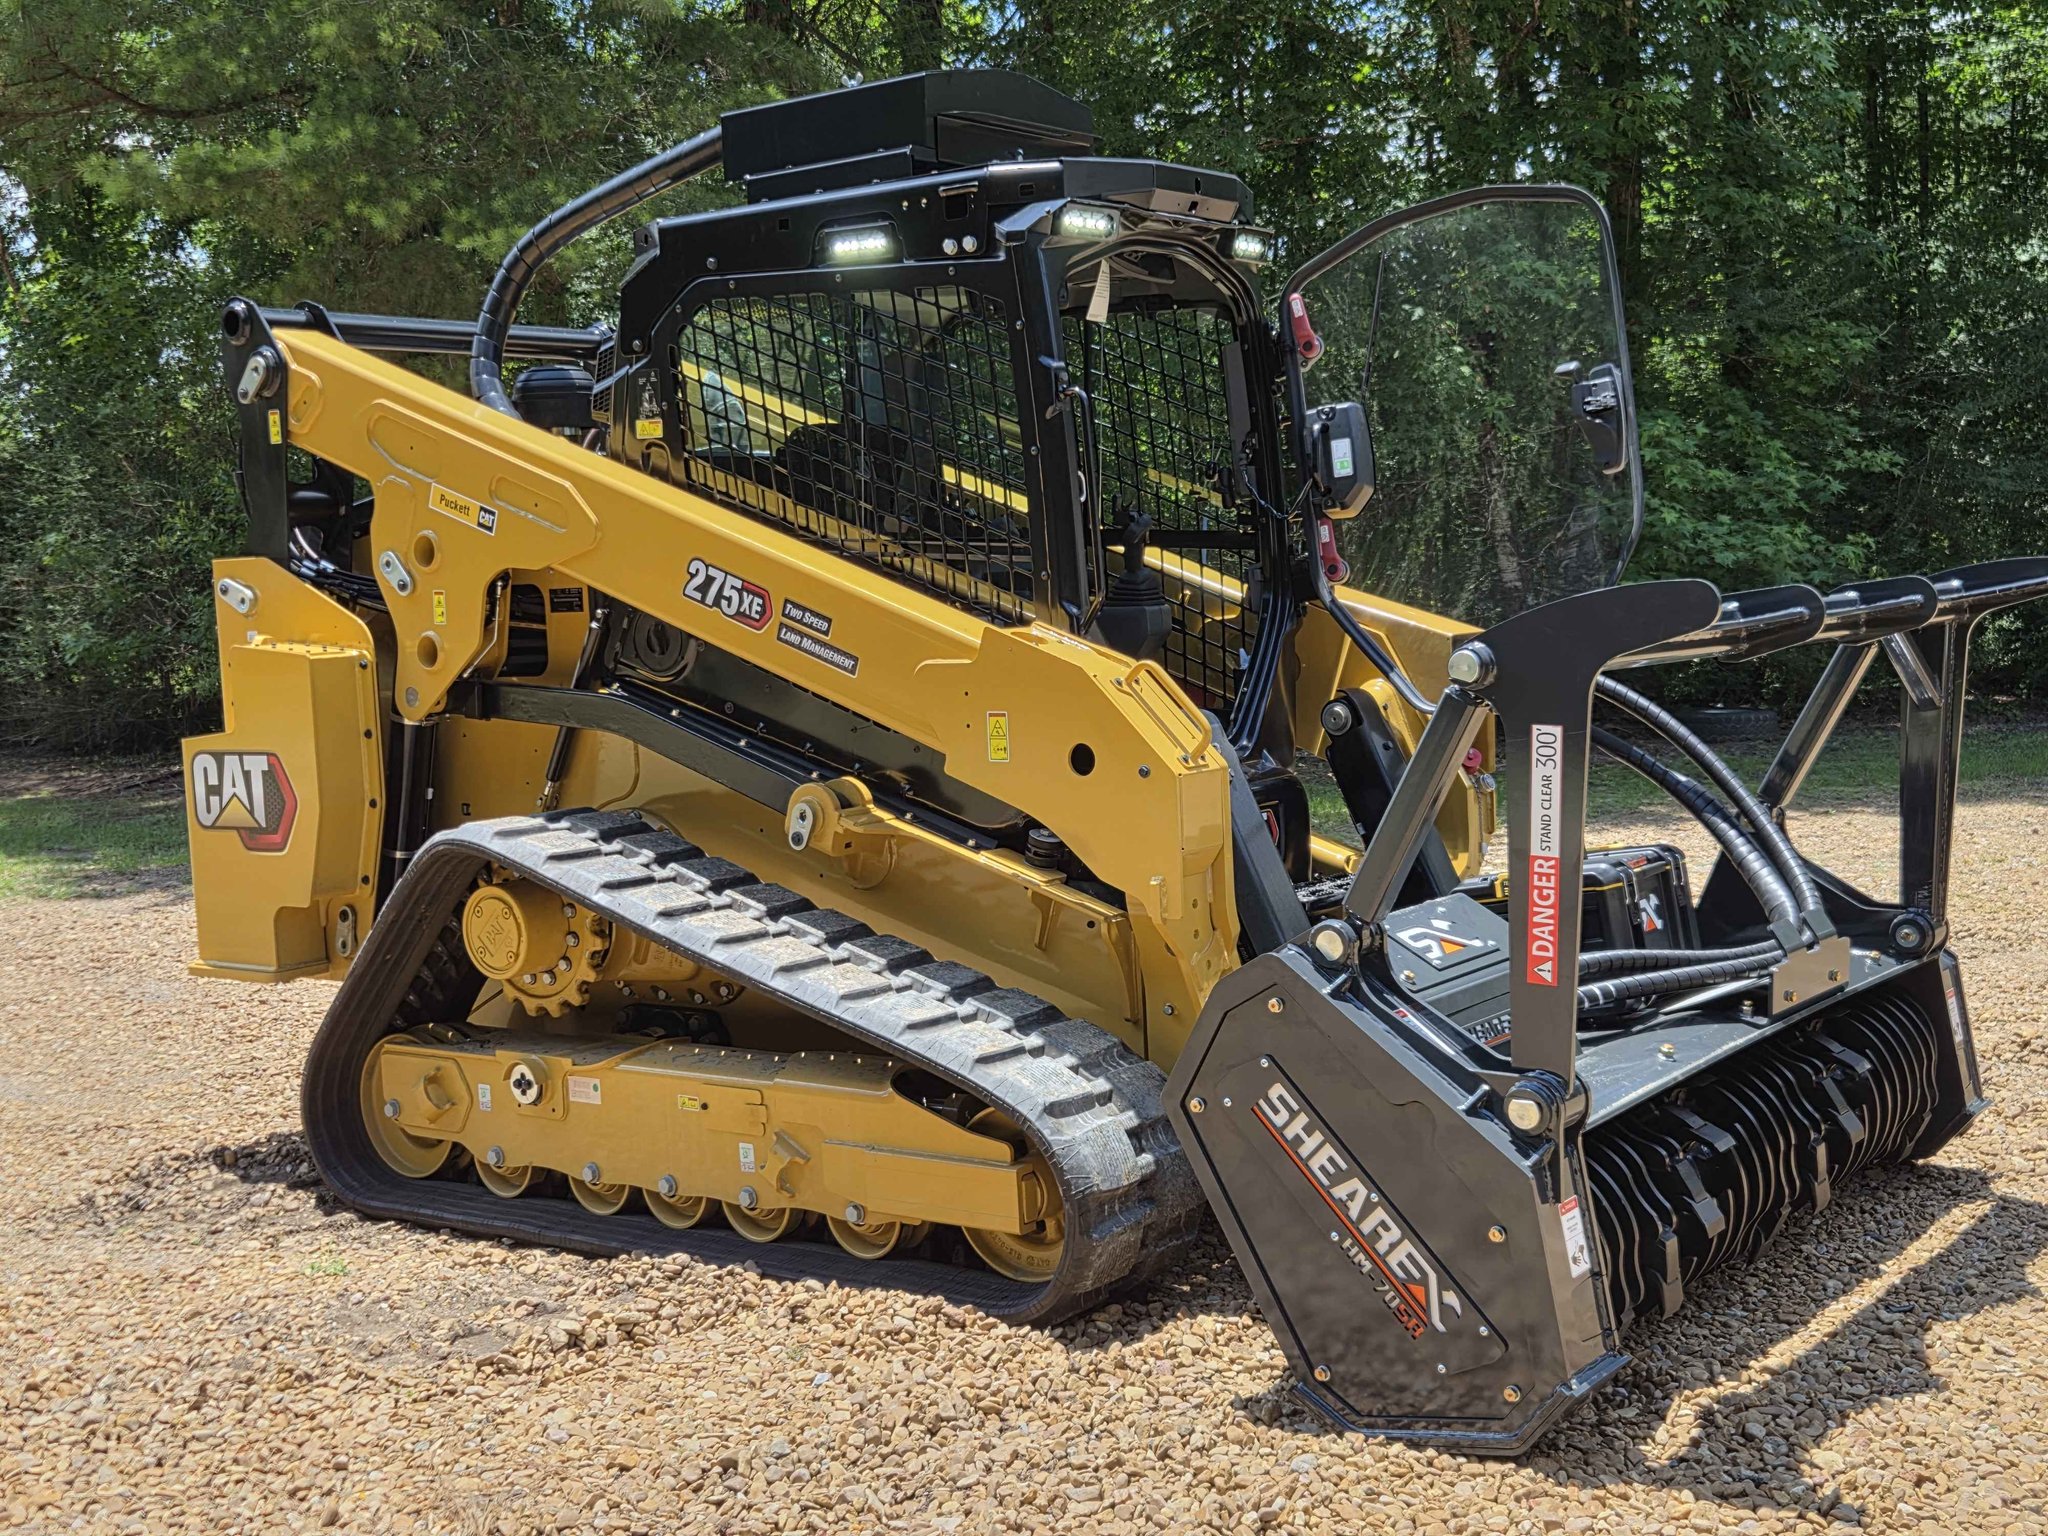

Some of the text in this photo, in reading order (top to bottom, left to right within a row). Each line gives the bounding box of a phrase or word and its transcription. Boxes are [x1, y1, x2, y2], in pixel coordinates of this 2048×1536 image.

[440, 494, 471, 517] Puckett
[479, 510, 495, 527] CAT
[193, 753, 268, 828] CAT
[1532, 727, 1557, 958] DANGER STAND CLEAR 300'
[1256, 1082, 1462, 1333] SHEAREX
